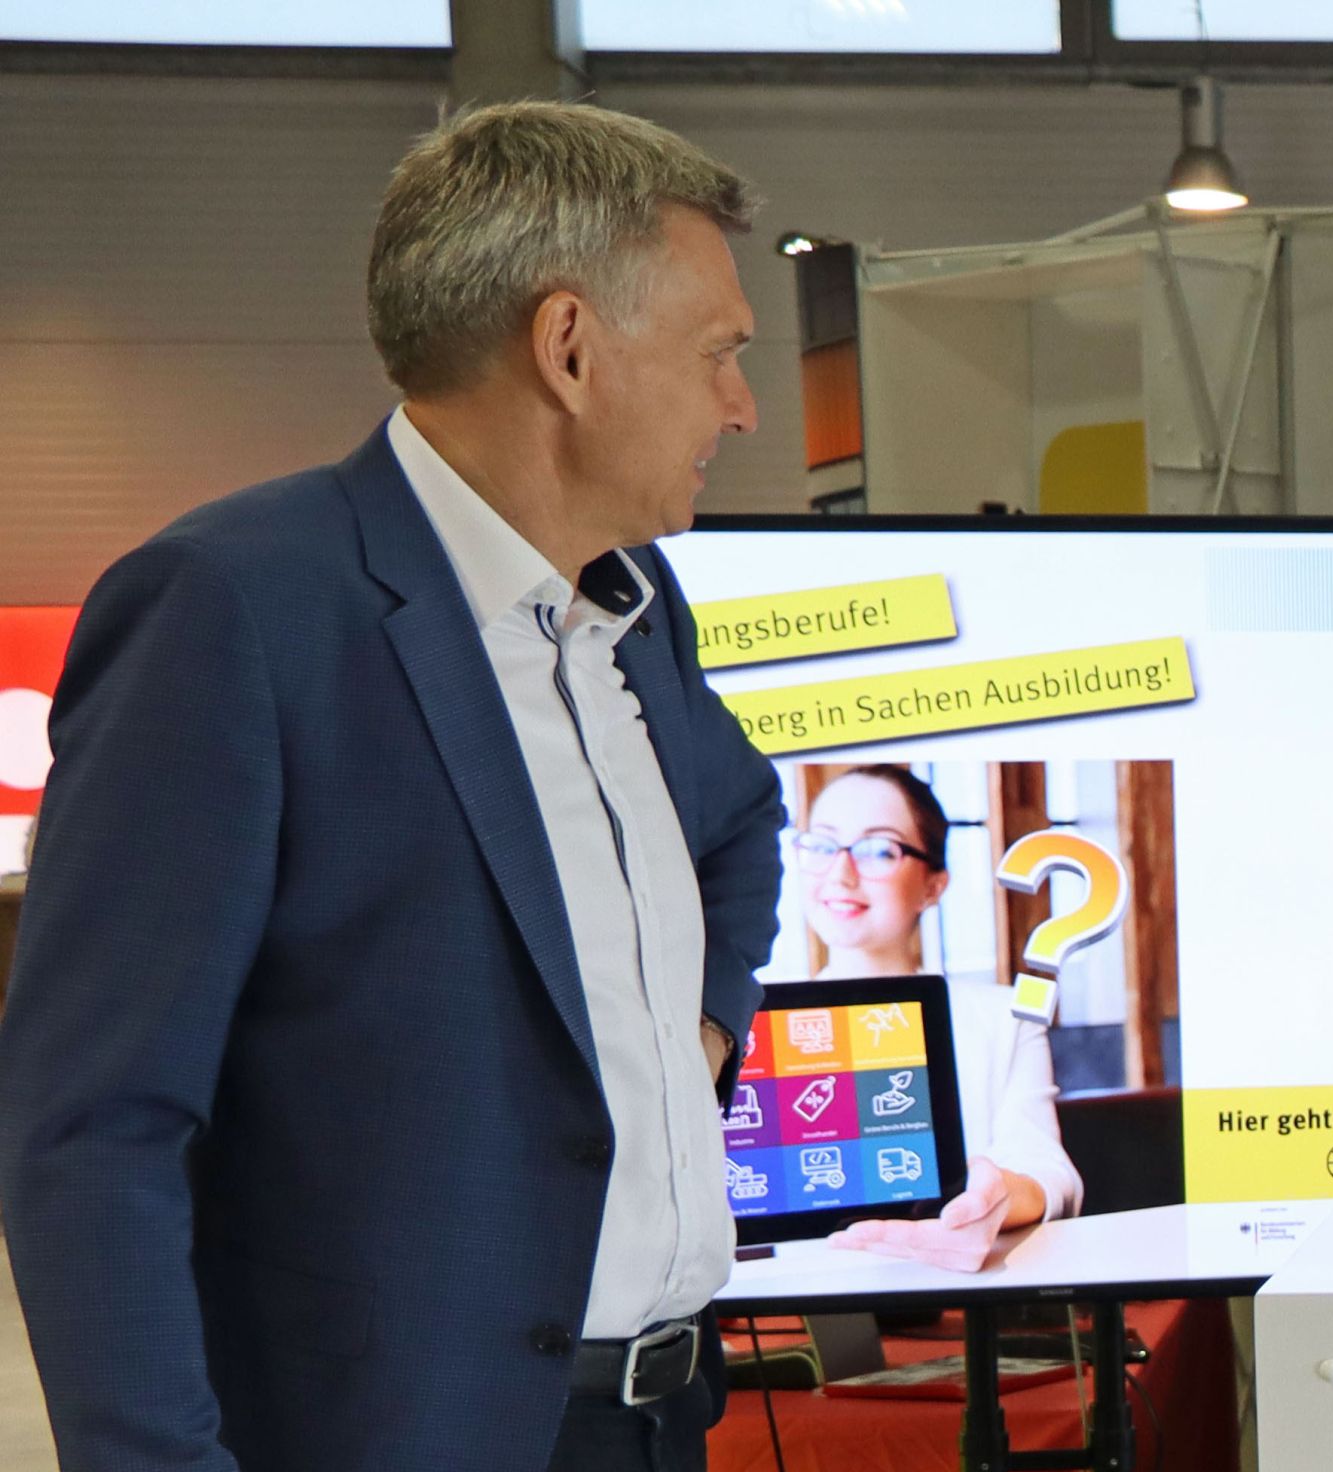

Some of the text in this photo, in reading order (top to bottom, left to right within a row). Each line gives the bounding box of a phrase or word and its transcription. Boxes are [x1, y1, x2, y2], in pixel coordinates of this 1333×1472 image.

[817, 699, 845, 727] in
[857, 685, 972, 723] Sachen
[984, 657, 1173, 706] Ausbildung!
[1218, 1110, 1268, 1132] Hier
